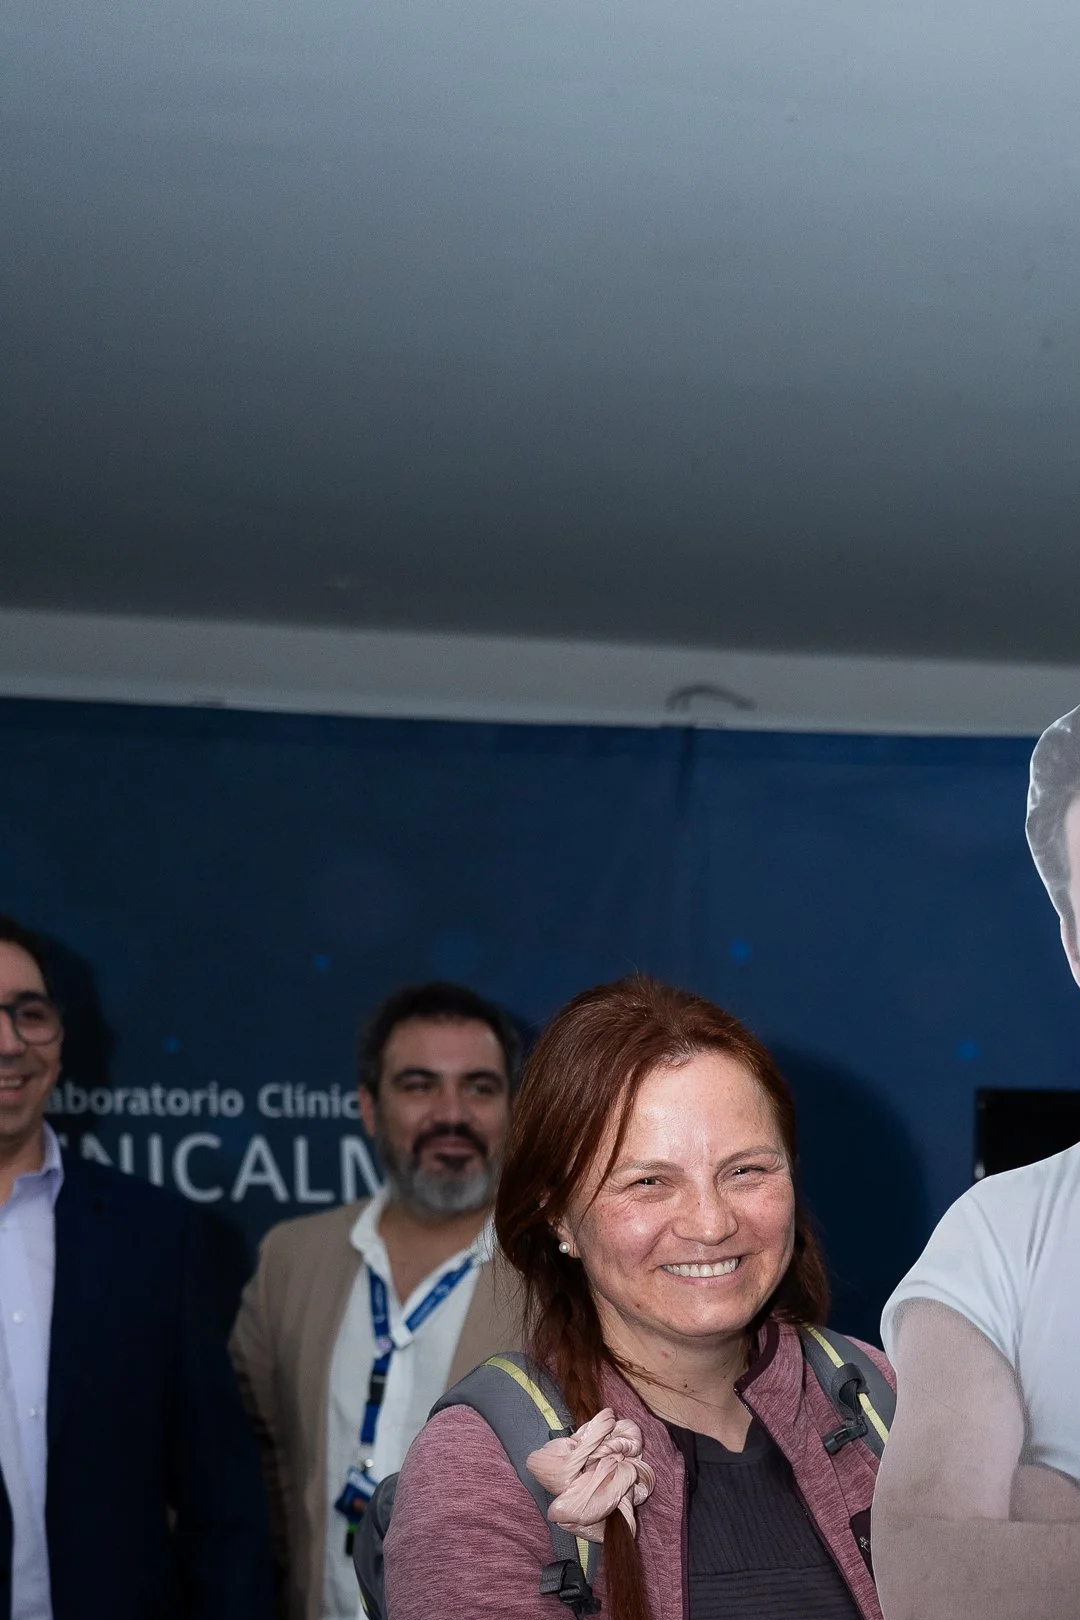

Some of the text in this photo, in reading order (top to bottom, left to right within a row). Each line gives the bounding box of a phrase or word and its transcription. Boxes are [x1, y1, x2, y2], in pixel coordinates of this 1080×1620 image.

[46, 1081, 363, 1119] aboratorio Clínic
[57, 1131, 386, 1204] NICALM
